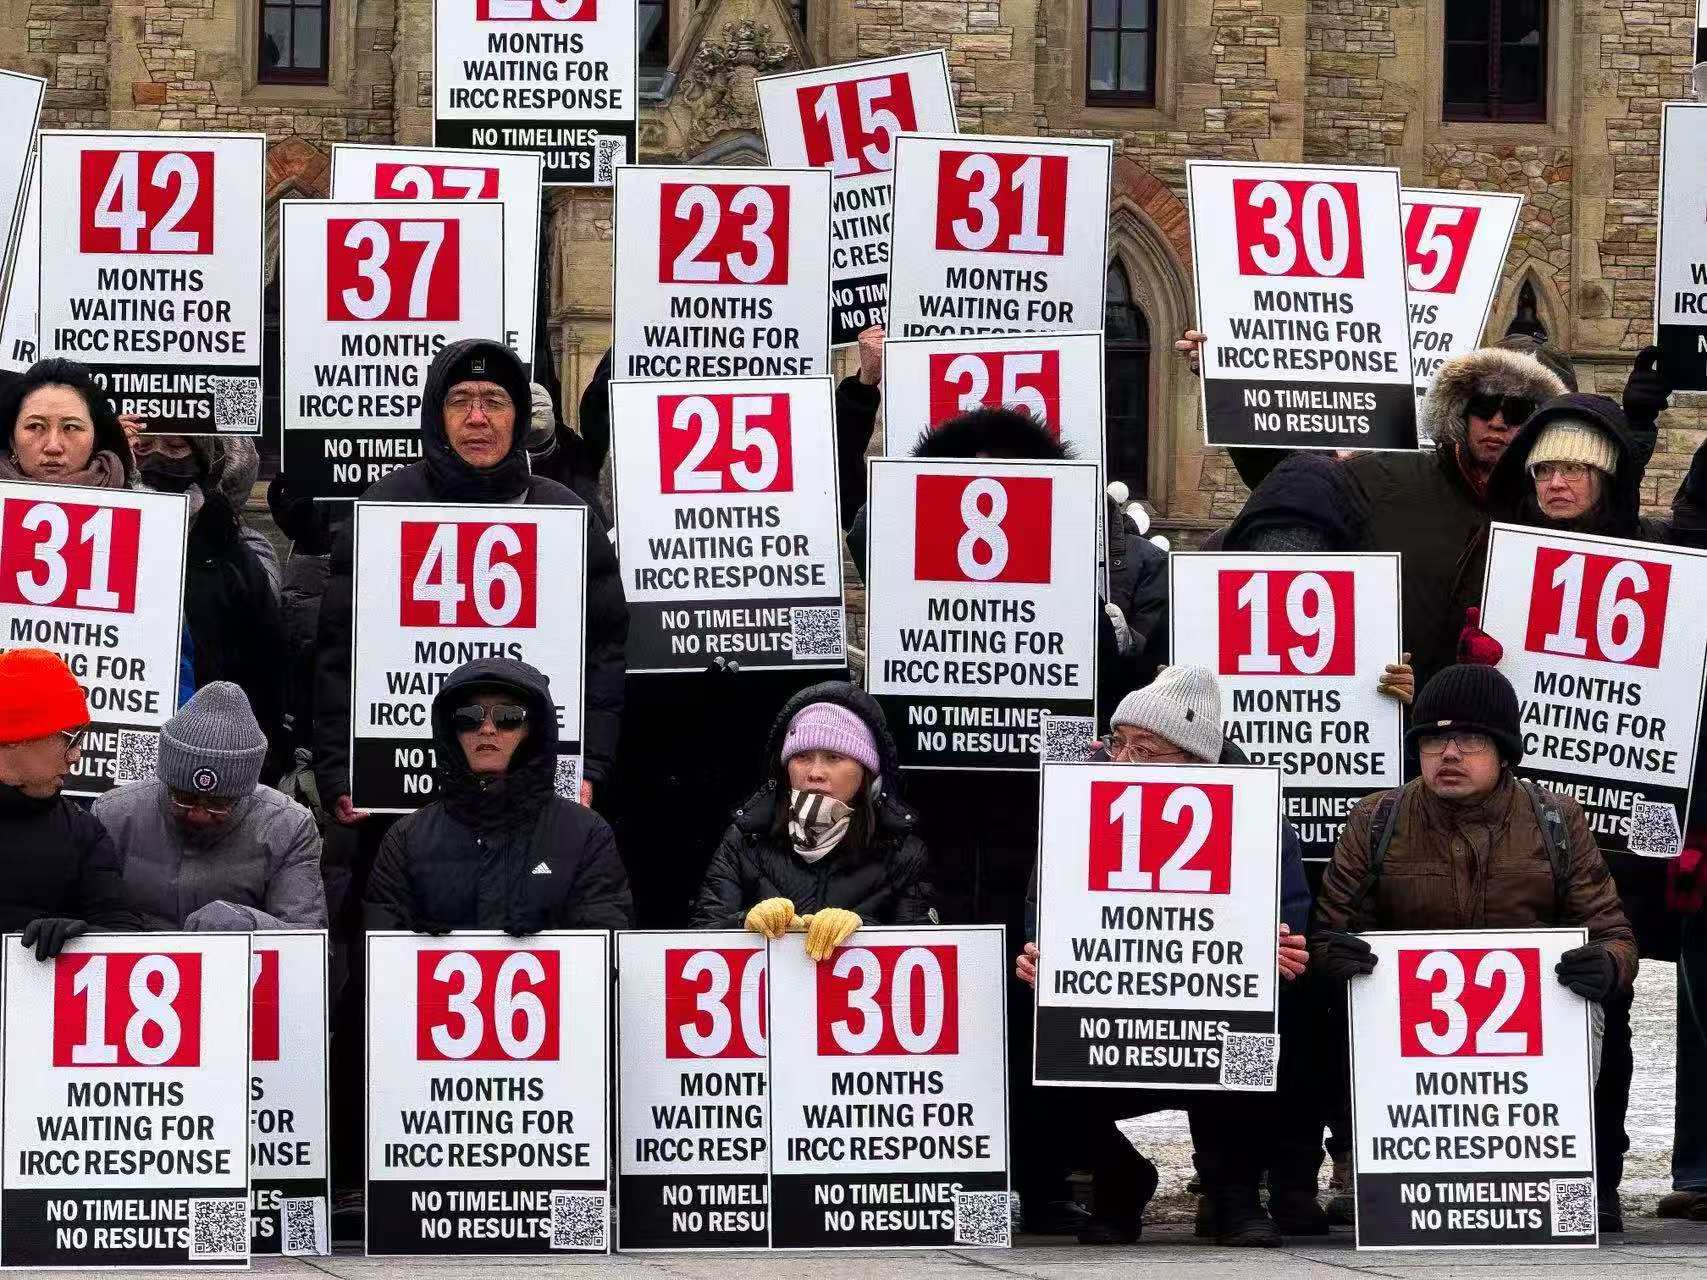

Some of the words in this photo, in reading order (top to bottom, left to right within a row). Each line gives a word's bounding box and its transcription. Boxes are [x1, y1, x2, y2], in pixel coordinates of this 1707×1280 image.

[489, 33, 583, 53] MONTHS
[463, 61, 557, 81] WAITING
[566, 61, 608, 81] FOR
[450, 88, 498, 108] IRCC
[503, 89, 622, 109] RESPONSE
[473, 129, 497, 145] NO
[502, 129, 599, 146] TIMELINES
[812, 76, 903, 176] 15
[95, 152, 199, 251] 42
[833, 184, 892, 213] MONT
[952, 154, 1049, 252] 31
[673, 185, 774, 283] 23
[832, 212, 891, 242] AITIN
[1249, 181, 1351, 276] 30
[98, 268, 203, 291] MONTHS
[342, 221, 444, 319] 37
[947, 268, 1047, 292] MONTHS
[70, 298, 174, 322] WAITING
[184, 300, 231, 322] FOR
[671, 297, 772, 319] MONTHS
[832, 286, 854, 310] NO
[919, 295, 1019, 320] WAITING
[1028, 300, 1073, 323] FOR
[1254, 291, 1353, 314] MONTHS
[841, 310, 865, 328] NO
[1230, 318, 1328, 341] WAITING
[1336, 322, 1382, 343] FOR
[55, 329, 108, 351] IRCC
[114, 329, 245, 353] RESPONSE
[342, 334, 447, 356] MONTHS
[644, 326, 744, 348] WAITING
[753, 328, 799, 349] FOR
[629, 355, 681, 377] IRCC
[686, 356, 813, 377] RESPONSE
[1218, 347, 1269, 368] IRCC
[1273, 348, 1397, 372] RESPONSE
[112, 374, 215, 393] TIMELINES
[315, 365, 418, 387] WAITING
[119, 399, 210, 419] RESULTS
[300, 395, 353, 417] IRCC
[357, 394, 422, 417] RESP
[1244, 389, 1270, 407] NO
[1274, 390, 1376, 410] TIMELINES
[1254, 413, 1280, 431] NO
[1287, 414, 1369, 433] RESULTS
[325, 439, 352, 457] NO
[355, 438, 423, 459] TIMELI
[672, 396, 778, 491] 25
[334, 464, 361, 482] NO
[675, 506, 780, 529] MONTHS
[958, 478, 1008, 580] 8
[16, 503, 119, 609] 31
[649, 536, 753, 560] WAITING
[762, 535, 809, 557] FOR
[413, 524, 522, 626] 46
[635, 568, 689, 589] IRCC
[694, 564, 825, 588] RESPONSE
[928, 598, 1035, 623] MONTHS
[1544, 554, 1649, 661] 16
[662, 611, 689, 629] NO
[1238, 572, 1335, 674] 19
[11, 618, 118, 648] MONTHS
[672, 635, 699, 653] NO
[704, 631, 792, 652] RESULTS
[900, 629, 1006, 653] WAITING
[1015, 632, 1064, 654] FOR
[414, 641, 523, 664] MONTHS
[97, 656, 145, 681] FOR
[884, 660, 939, 683] IRCC
[944, 661, 1078, 686] RESPONSE
[386, 671, 448, 694] WAIT
[1534, 671, 1641, 706] MONTHS
[1234, 690, 1340, 712] MONTHS
[371, 703, 425, 726] IRCC
[909, 706, 937, 725] NO
[1321, 721, 1370, 743] FOR
[1617, 713, 1666, 741] FOR
[918, 732, 946, 751] NO
[953, 730, 1042, 754] RESULTS
[395, 749, 423, 767] NO
[1250, 751, 1386, 776] RESPONSE
[1543, 735, 1677, 774] RESPONSE
[69, 756, 118, 778] ULTS
[404, 775, 432, 793] NO
[1107, 786, 1214, 892] 12
[1102, 906, 1214, 931] MONTHS
[1072, 938, 1182, 963] WAITING
[1193, 941, 1243, 964] FOR
[1055, 970, 1112, 994] IRCC
[1118, 972, 1258, 997] RESPONSE
[72, 955, 181, 1065] 18
[430, 951, 547, 1059] 36
[831, 947, 944, 1054] 30
[1415, 950, 1528, 1056] 32
[1080, 1018, 1110, 1038] NO
[1114, 1017, 1230, 1042] TIMELINES
[1090, 1046, 1119, 1065] NO
[1124, 1046, 1221, 1070] RESULTS
[68, 1082, 183, 1106] MONTHS
[431, 1078, 543, 1101] MONTHS
[832, 1071, 943, 1095] MONTHS
[1416, 1071, 1528, 1095] MONTHS
[401, 1111, 513, 1134] WAITING
[523, 1110, 574, 1134] FOR
[652, 1105, 762, 1129] WAITING
[803, 1104, 913, 1128] WAITING
[924, 1103, 974, 1126] FOR
[1388, 1104, 1499, 1127] WAITING
[1509, 1103, 1559, 1126] FOR
[37, 1116, 151, 1141] WAITING
[162, 1116, 214, 1140] FOR
[385, 1144, 443, 1167] IRCC
[449, 1143, 589, 1167] RESPONSE
[636, 1138, 693, 1162] IRCC
[696, 1139, 766, 1162] RESP
[788, 1137, 844, 1161] IRCC
[851, 1135, 990, 1160] RESPONSE
[1373, 1137, 1430, 1160] IRCC
[1436, 1135, 1576, 1159] RESPONSE
[20, 1150, 79, 1175] IRCC
[85, 1150, 230, 1175] RESPONSE
[412, 1191, 442, 1211] NO
[664, 1185, 692, 1205] NO
[698, 1185, 768, 1205] TIMELI
[815, 1184, 844, 1204] NO
[849, 1183, 963, 1203] TIMELINES
[1401, 1183, 1431, 1203] NO
[1433, 1183, 1550, 1203] TIMELINES
[47, 1200, 77, 1221] NO
[82, 1199, 189, 1222] TIMELINE
[673, 1212, 702, 1232] NO
[708, 1212, 768, 1232] RESU
[825, 1211, 854, 1231] NO
[861, 1209, 955, 1231] RESULTS
[1411, 1210, 1441, 1229] NO
[1448, 1209, 1542, 1229] RESULTS
[57, 1228, 87, 1249] NO
[91, 1226, 190, 1249] RESULTS
[422, 1218, 451, 1238] NO
[456, 1218, 551, 1240] RESULTS
